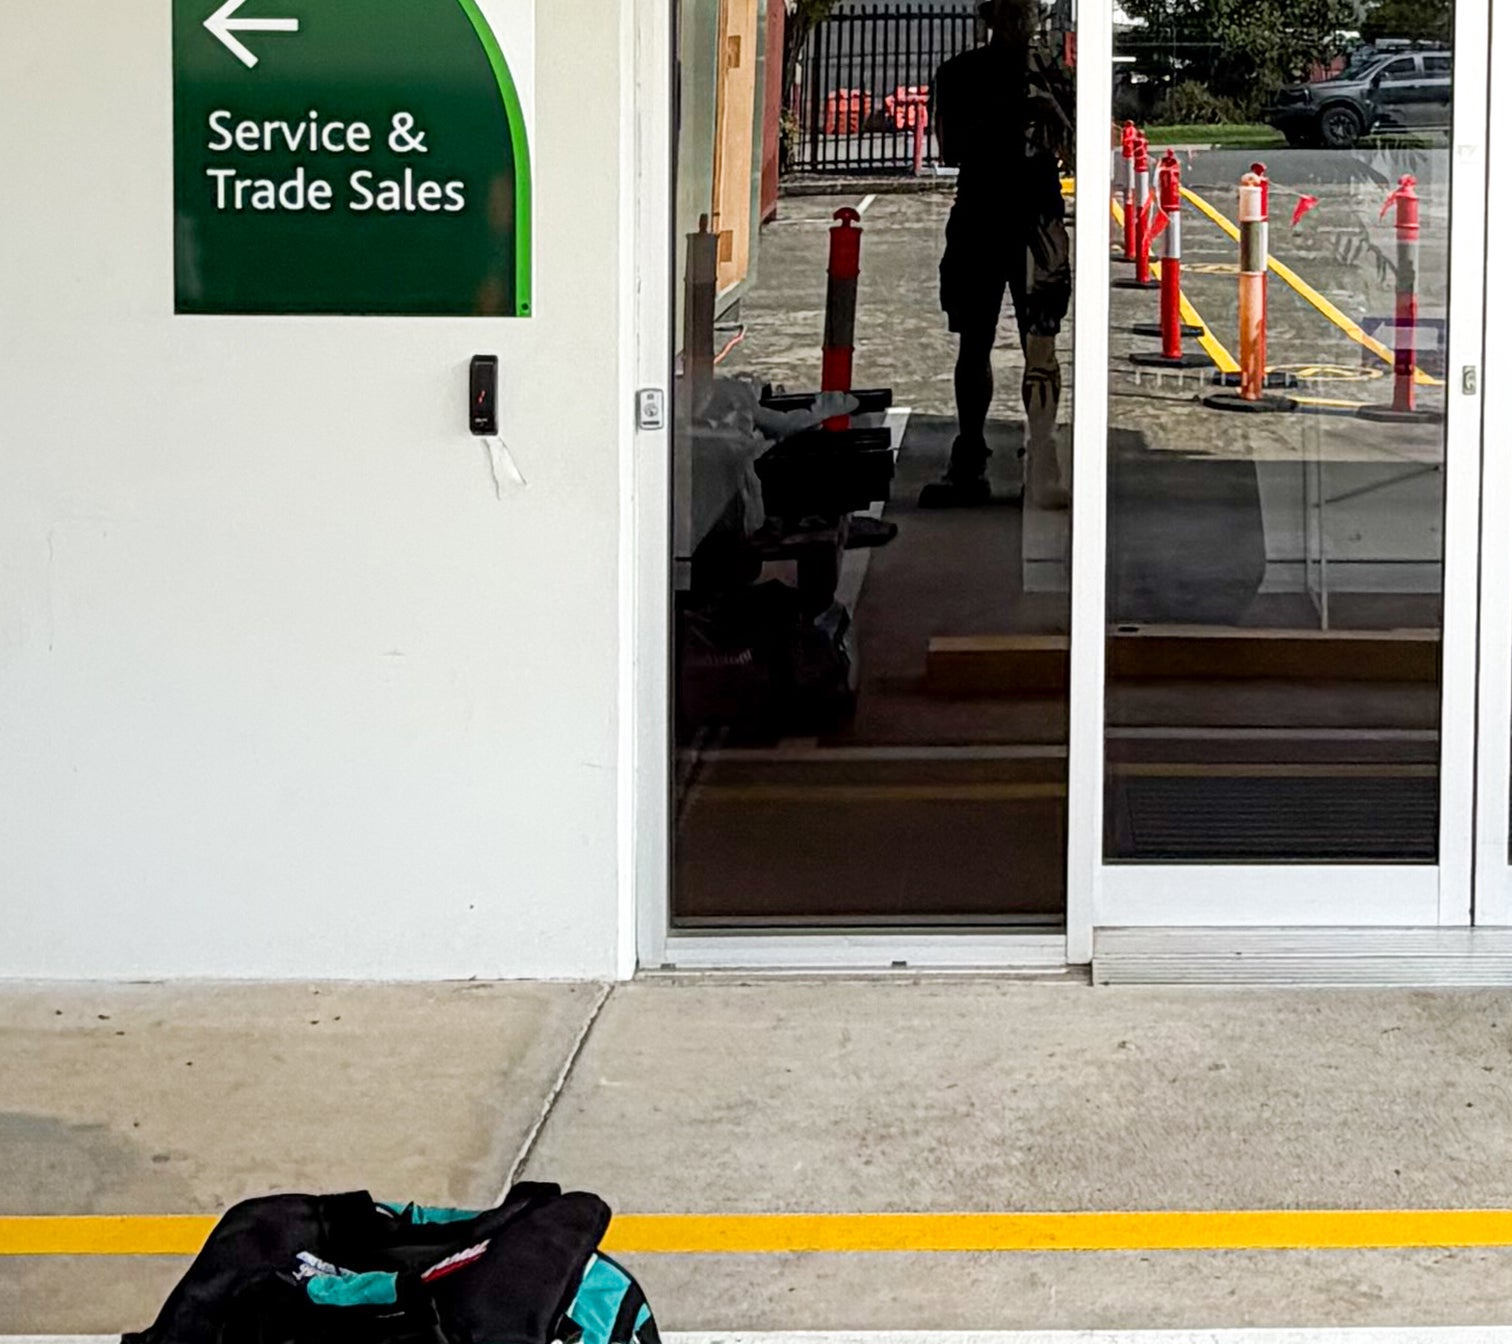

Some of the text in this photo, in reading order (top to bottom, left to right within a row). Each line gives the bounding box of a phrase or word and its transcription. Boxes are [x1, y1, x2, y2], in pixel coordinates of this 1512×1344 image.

[208, 110, 428, 153] Service &
[206, 166, 465, 212] Trade Sales
